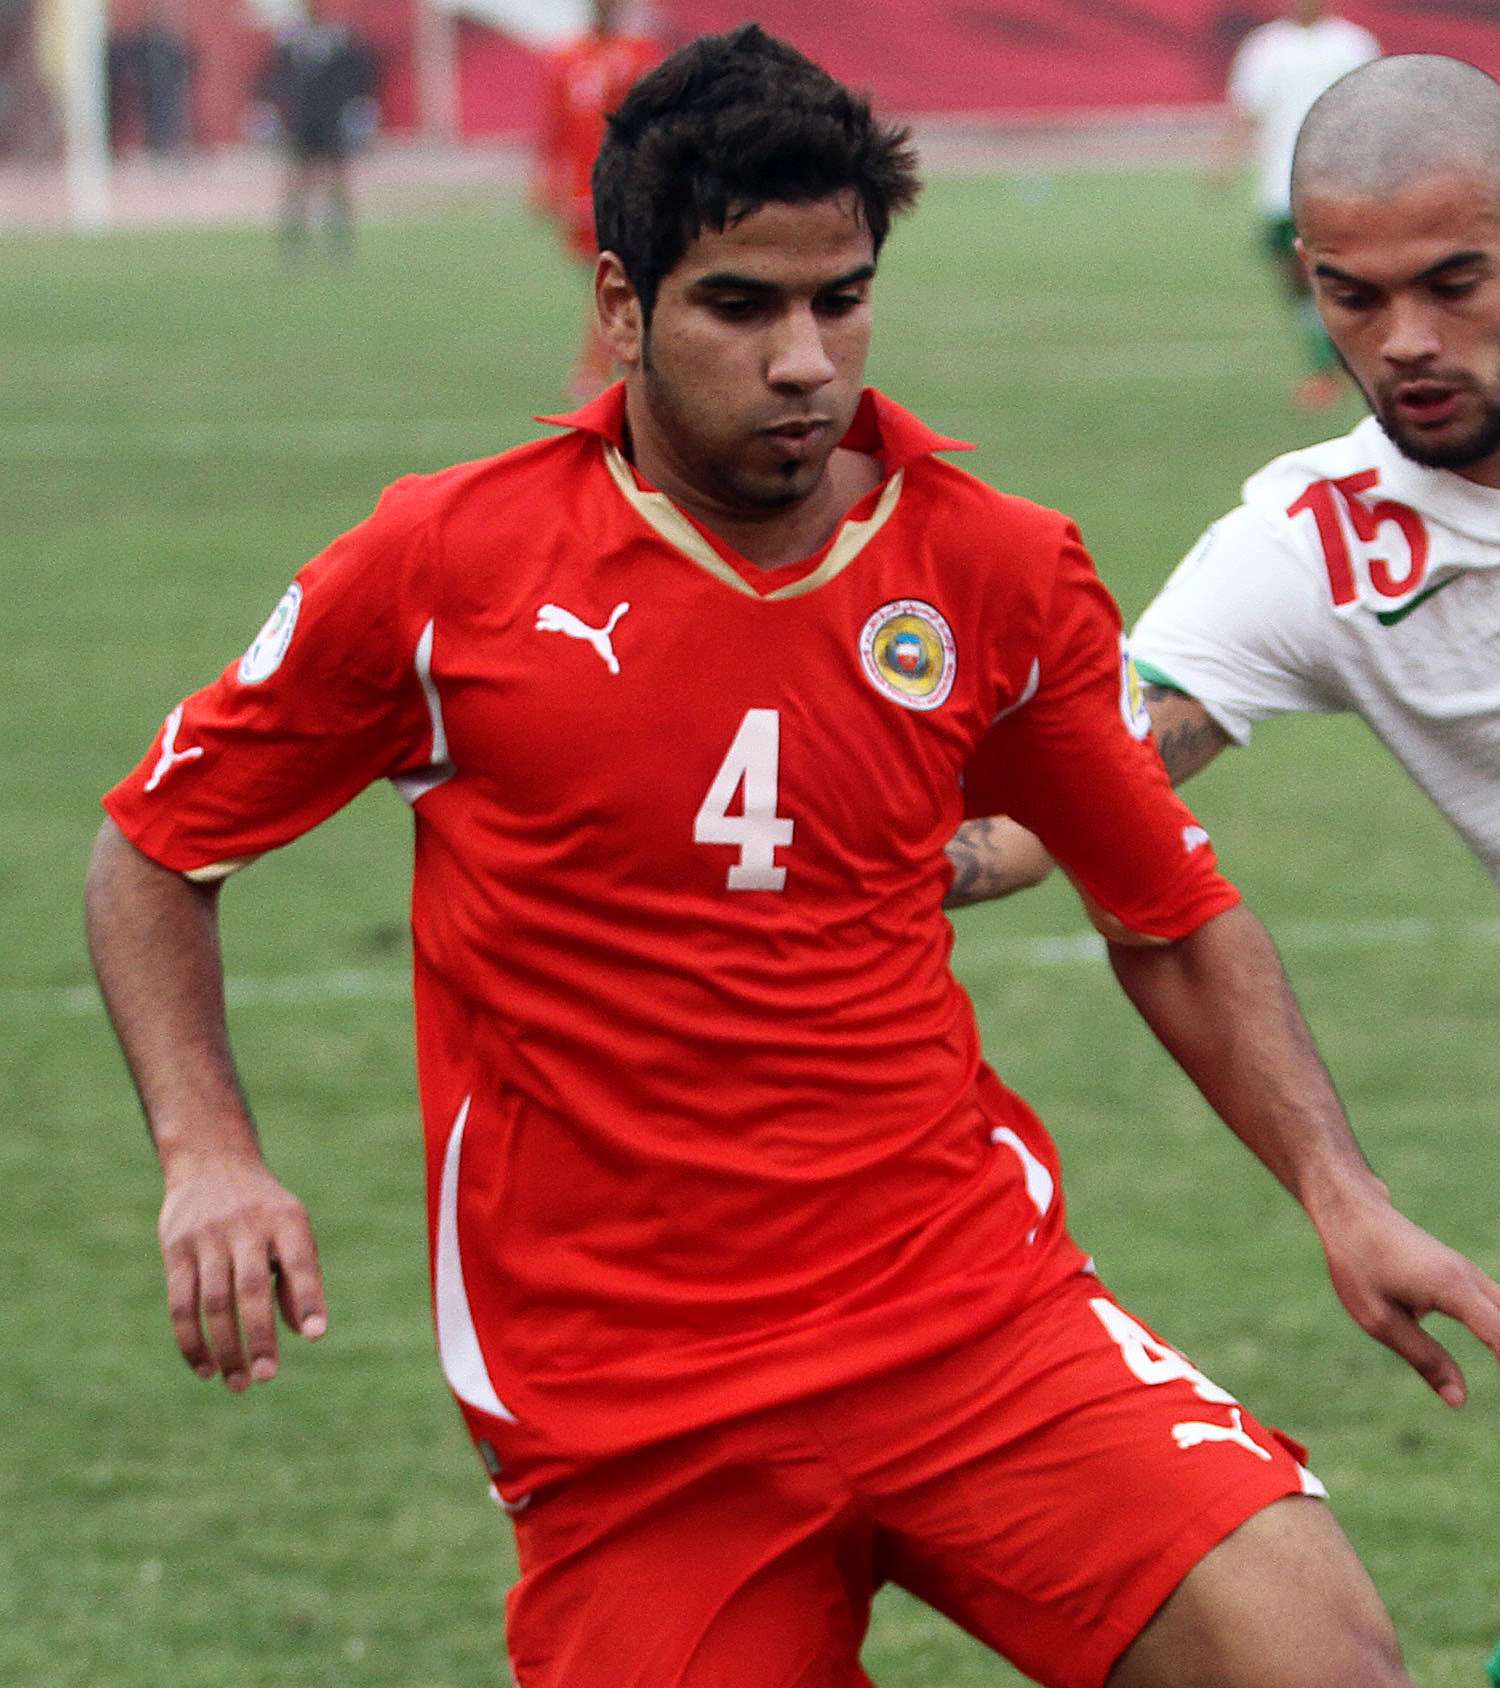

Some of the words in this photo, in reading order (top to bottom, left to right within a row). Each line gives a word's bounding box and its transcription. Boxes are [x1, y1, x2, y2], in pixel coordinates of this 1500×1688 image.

[1286, 467, 1430, 606] 15
[694, 708, 794, 891] 4
[1089, 1298, 1240, 1404] 4
